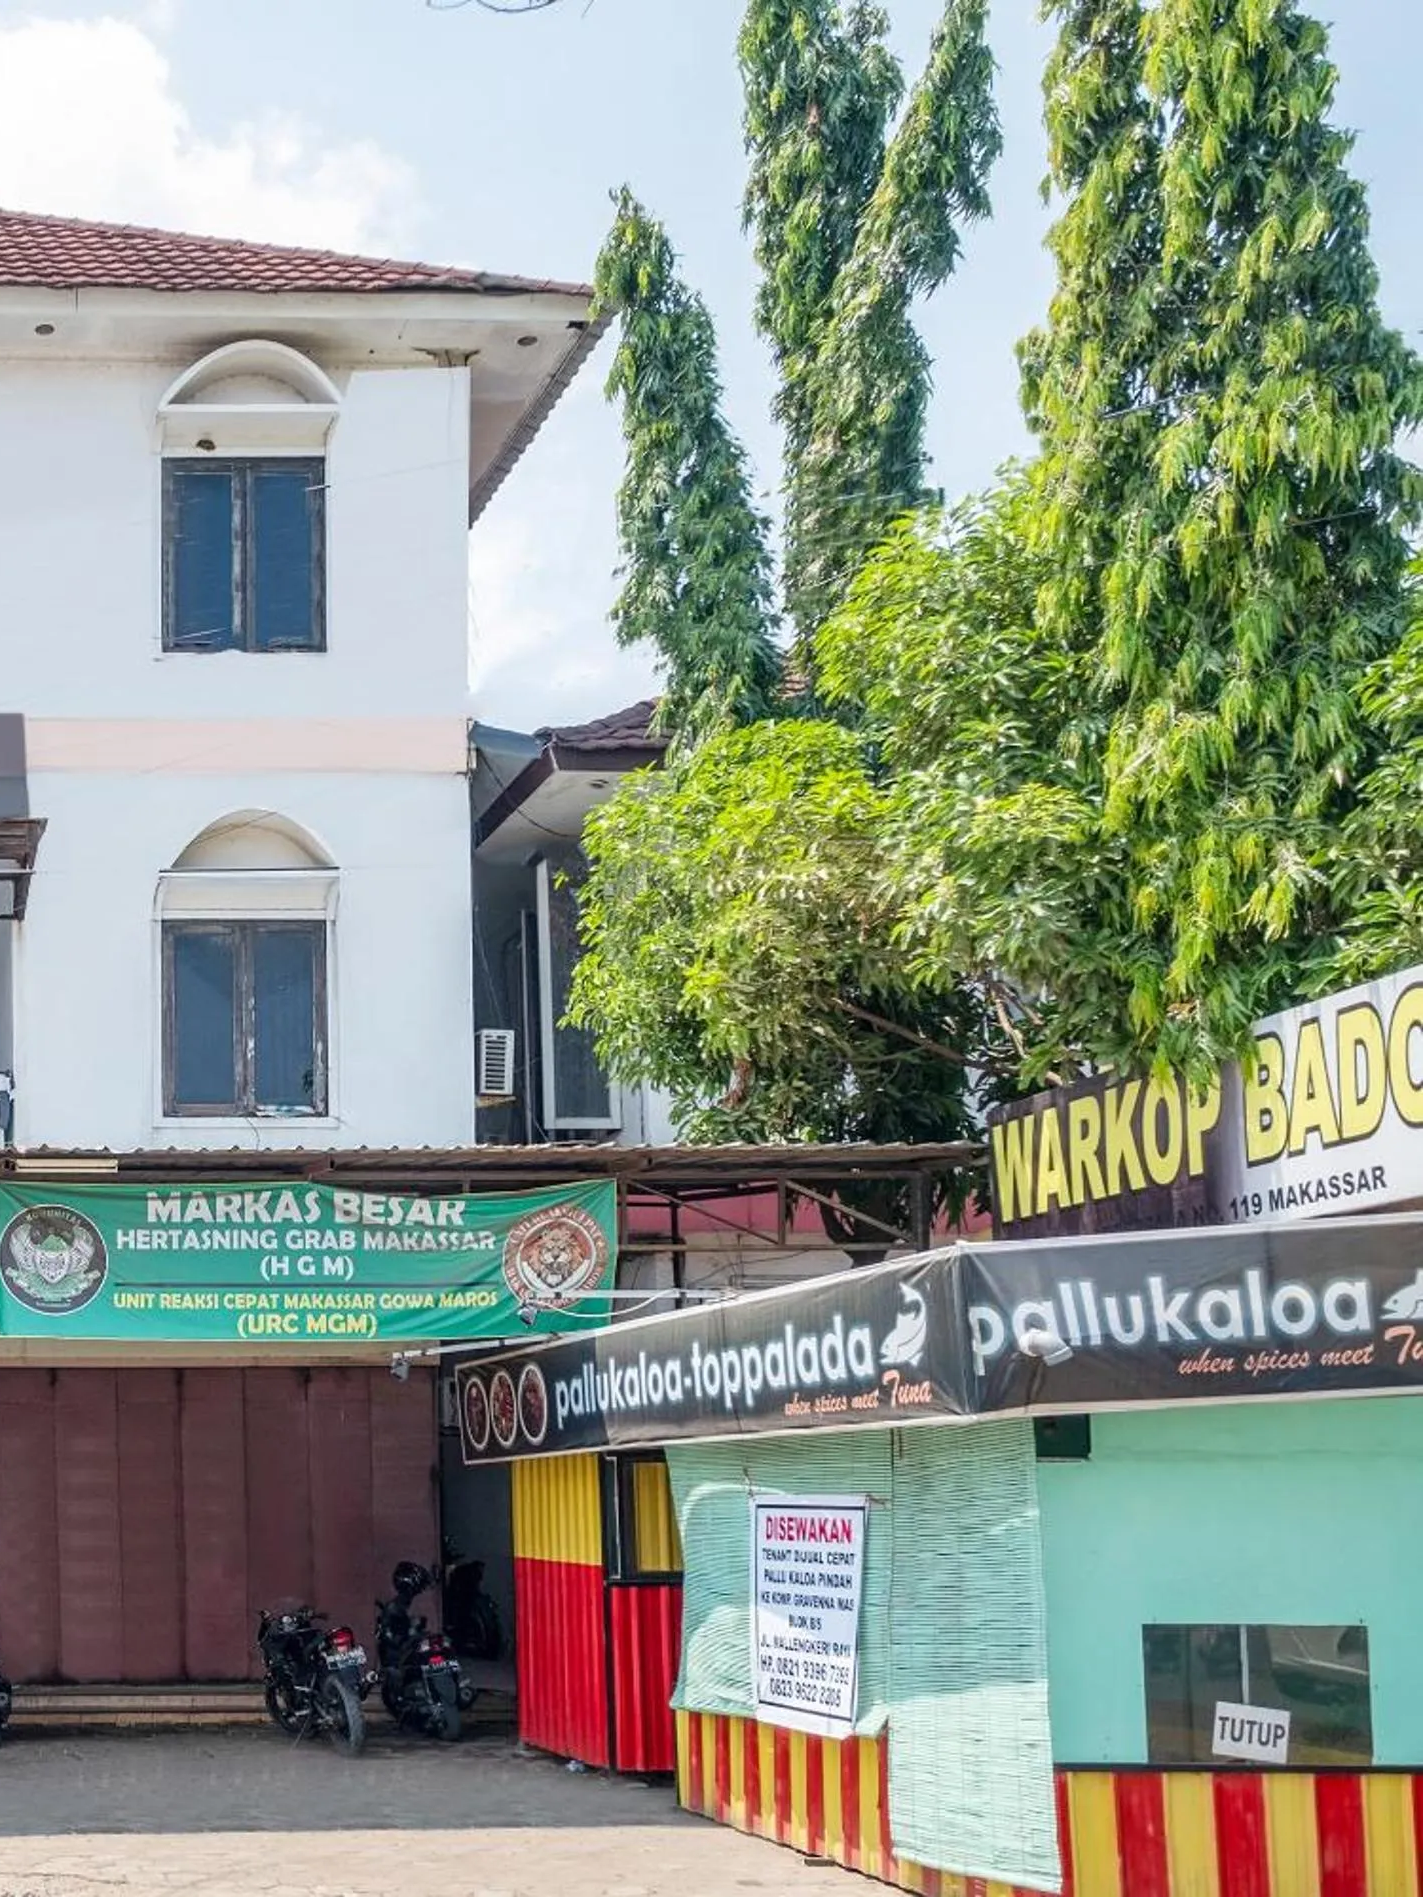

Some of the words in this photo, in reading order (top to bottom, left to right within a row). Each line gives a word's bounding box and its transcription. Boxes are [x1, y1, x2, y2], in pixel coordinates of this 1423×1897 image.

[991, 1070, 1222, 1224] WARKOP
[146, 1190, 321, 1224] MARKAS
[333, 1191, 466, 1226] BESAR
[1229, 1193, 1264, 1221] 119
[1268, 1165, 1387, 1213] MAKASSAR
[116, 1229, 277, 1250] HERTASNING
[285, 1229, 356, 1250] GRAB
[363, 1230, 497, 1251] MAKASSAR
[259, 1255, 289, 1282] (H
[297, 1255, 316, 1276] G
[323, 1255, 354, 1282] M)
[113, 1292, 155, 1309] UNIT
[160, 1292, 219, 1309] REAKSI
[223, 1293, 280, 1310] CEPAT
[283, 1293, 375, 1309] MAKASSAR
[379, 1293, 435, 1309] GOWA
[438, 1291, 498, 1307] MAROS
[237, 1313, 299, 1338] (URC
[307, 1313, 377, 1338] MGM)
[968, 1268, 1372, 1377] pallukaloa
[555, 1313, 875, 1430] pallukaloa-toppalada
[1178, 1348, 1235, 1375] when
[1243, 1349, 1311, 1377] spices
[1320, 1343, 1375, 1368] meet
[881, 1369, 933, 1408] Tuna
[766, 1516, 852, 1544] DISEWAKAN
[762, 1547, 792, 1562] TENANT
[826, 1551, 855, 1566] CEPAT
[818, 1572, 853, 1589] PINDAH
[1218, 1715, 1286, 1749] TUTUP
